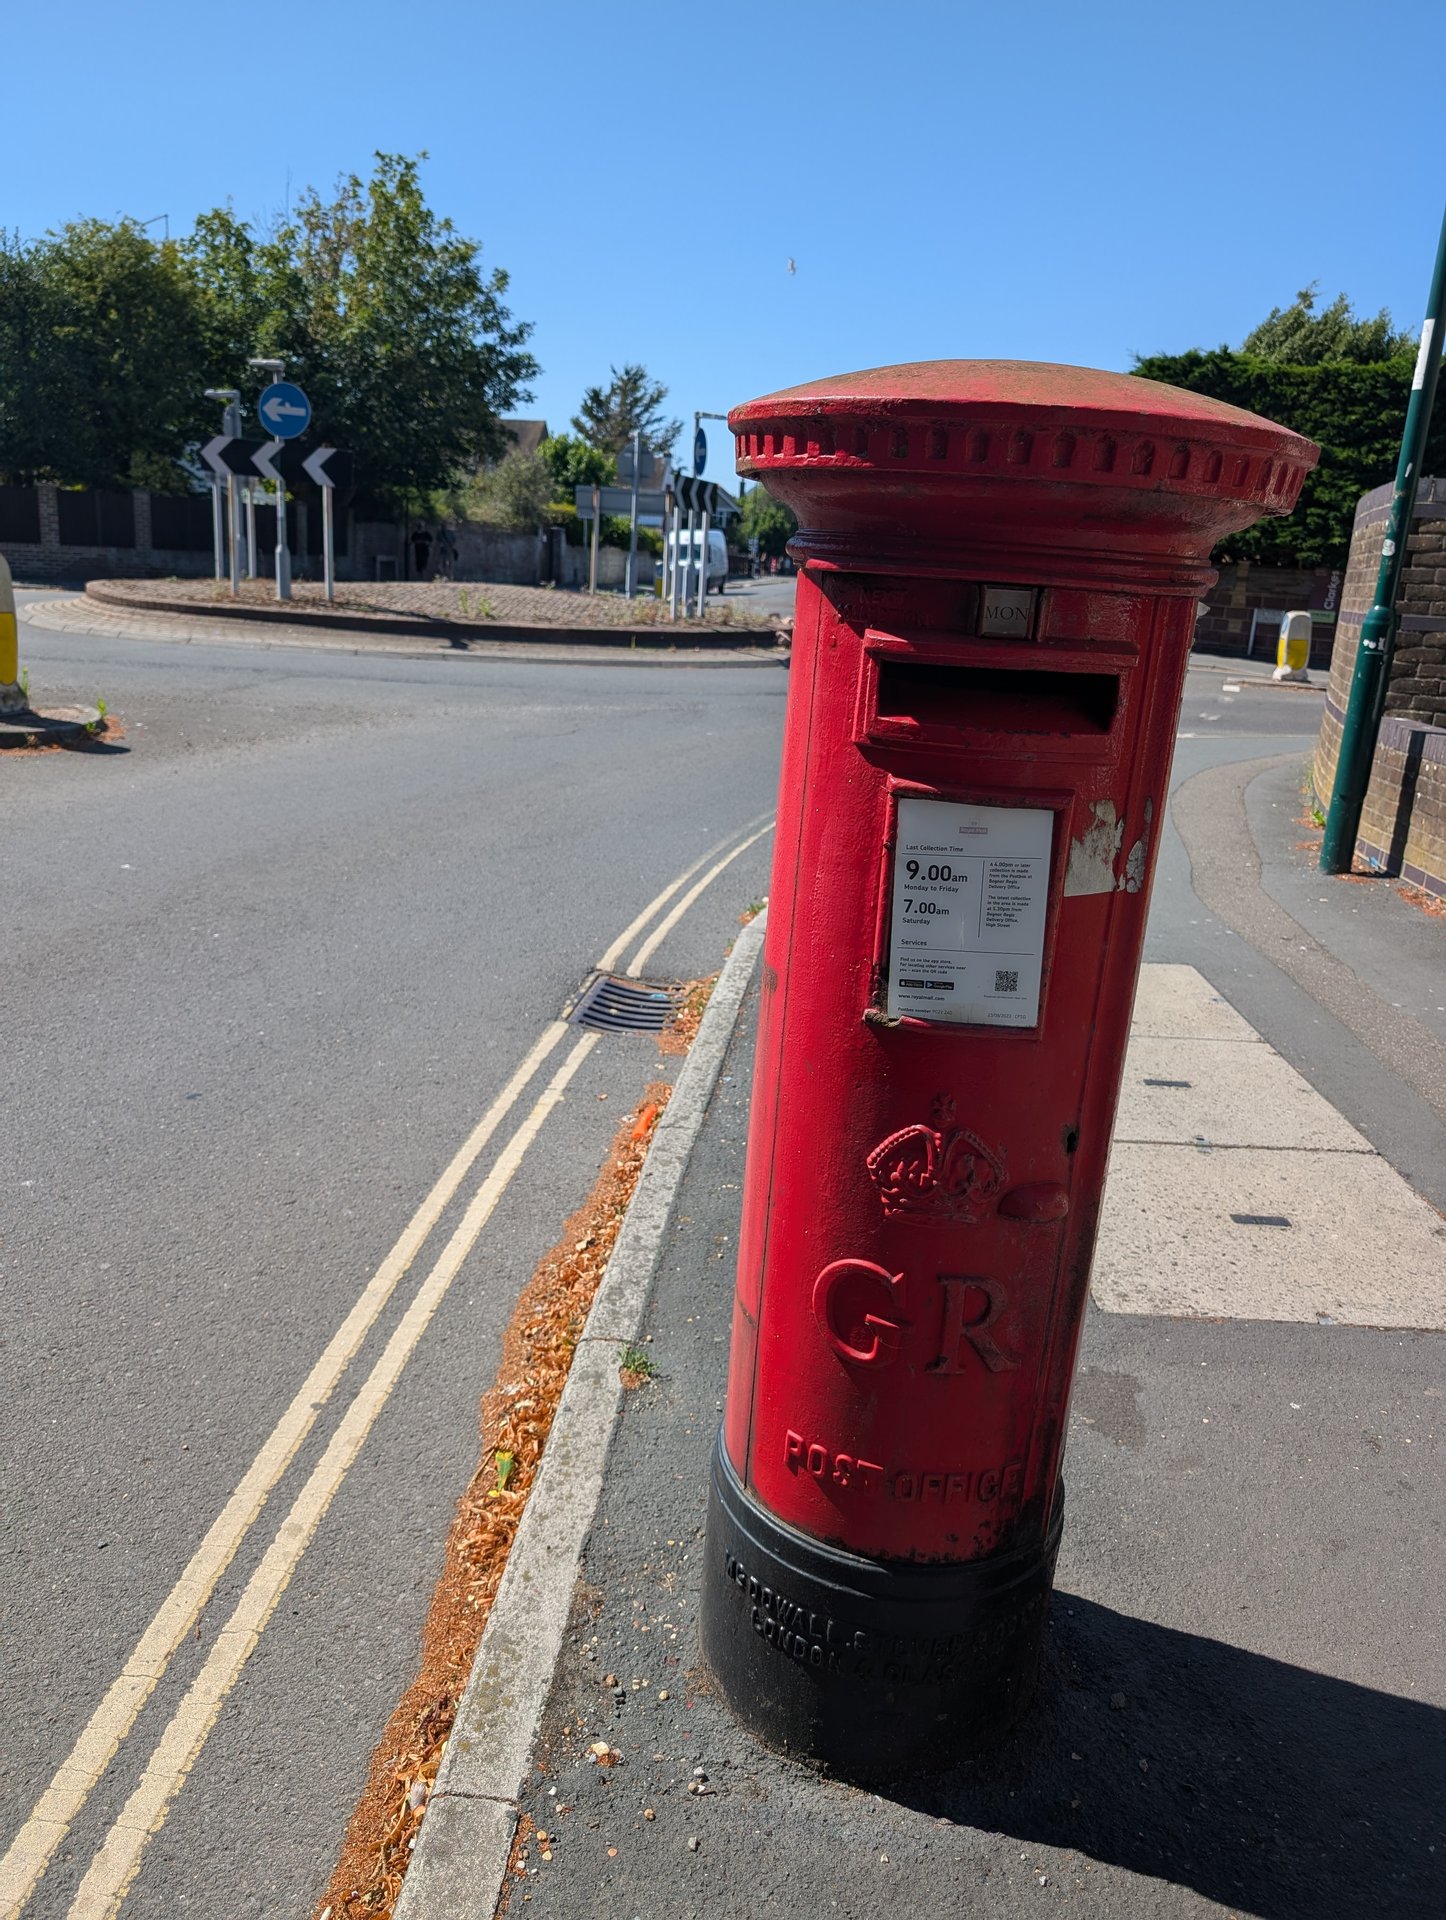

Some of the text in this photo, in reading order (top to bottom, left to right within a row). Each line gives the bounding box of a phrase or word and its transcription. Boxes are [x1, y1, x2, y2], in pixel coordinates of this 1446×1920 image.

[984, 606, 1030, 620] MON
[906, 860, 968, 882] 9.00am
[904, 899, 949, 915] 7.00am
[902, 917, 930, 925] Saturday
[812, 1258, 1022, 1374] G R
[784, 1428, 1022, 1502] POST OFFICE
